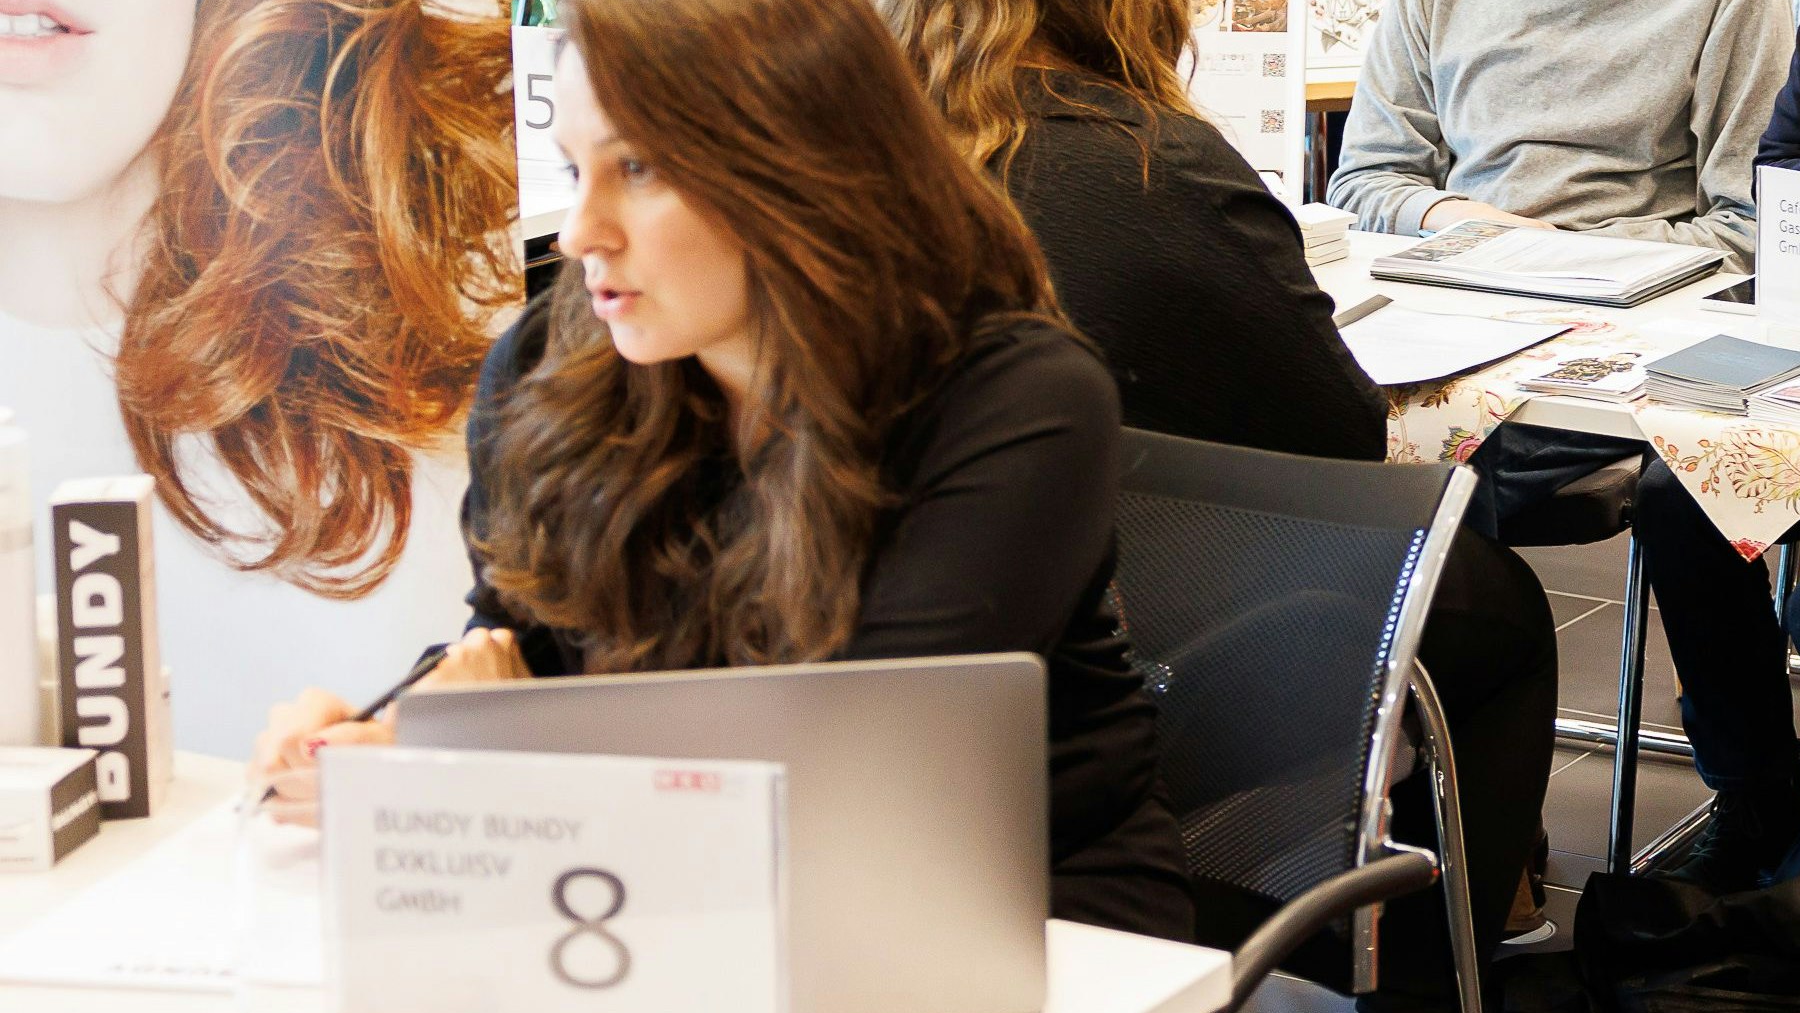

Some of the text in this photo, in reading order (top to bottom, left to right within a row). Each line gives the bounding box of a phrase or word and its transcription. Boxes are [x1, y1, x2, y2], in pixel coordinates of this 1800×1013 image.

[525, 73, 554, 130] 5
[374, 808, 585, 842] BUNDY BUNDY
[549, 865, 633, 992] 8
